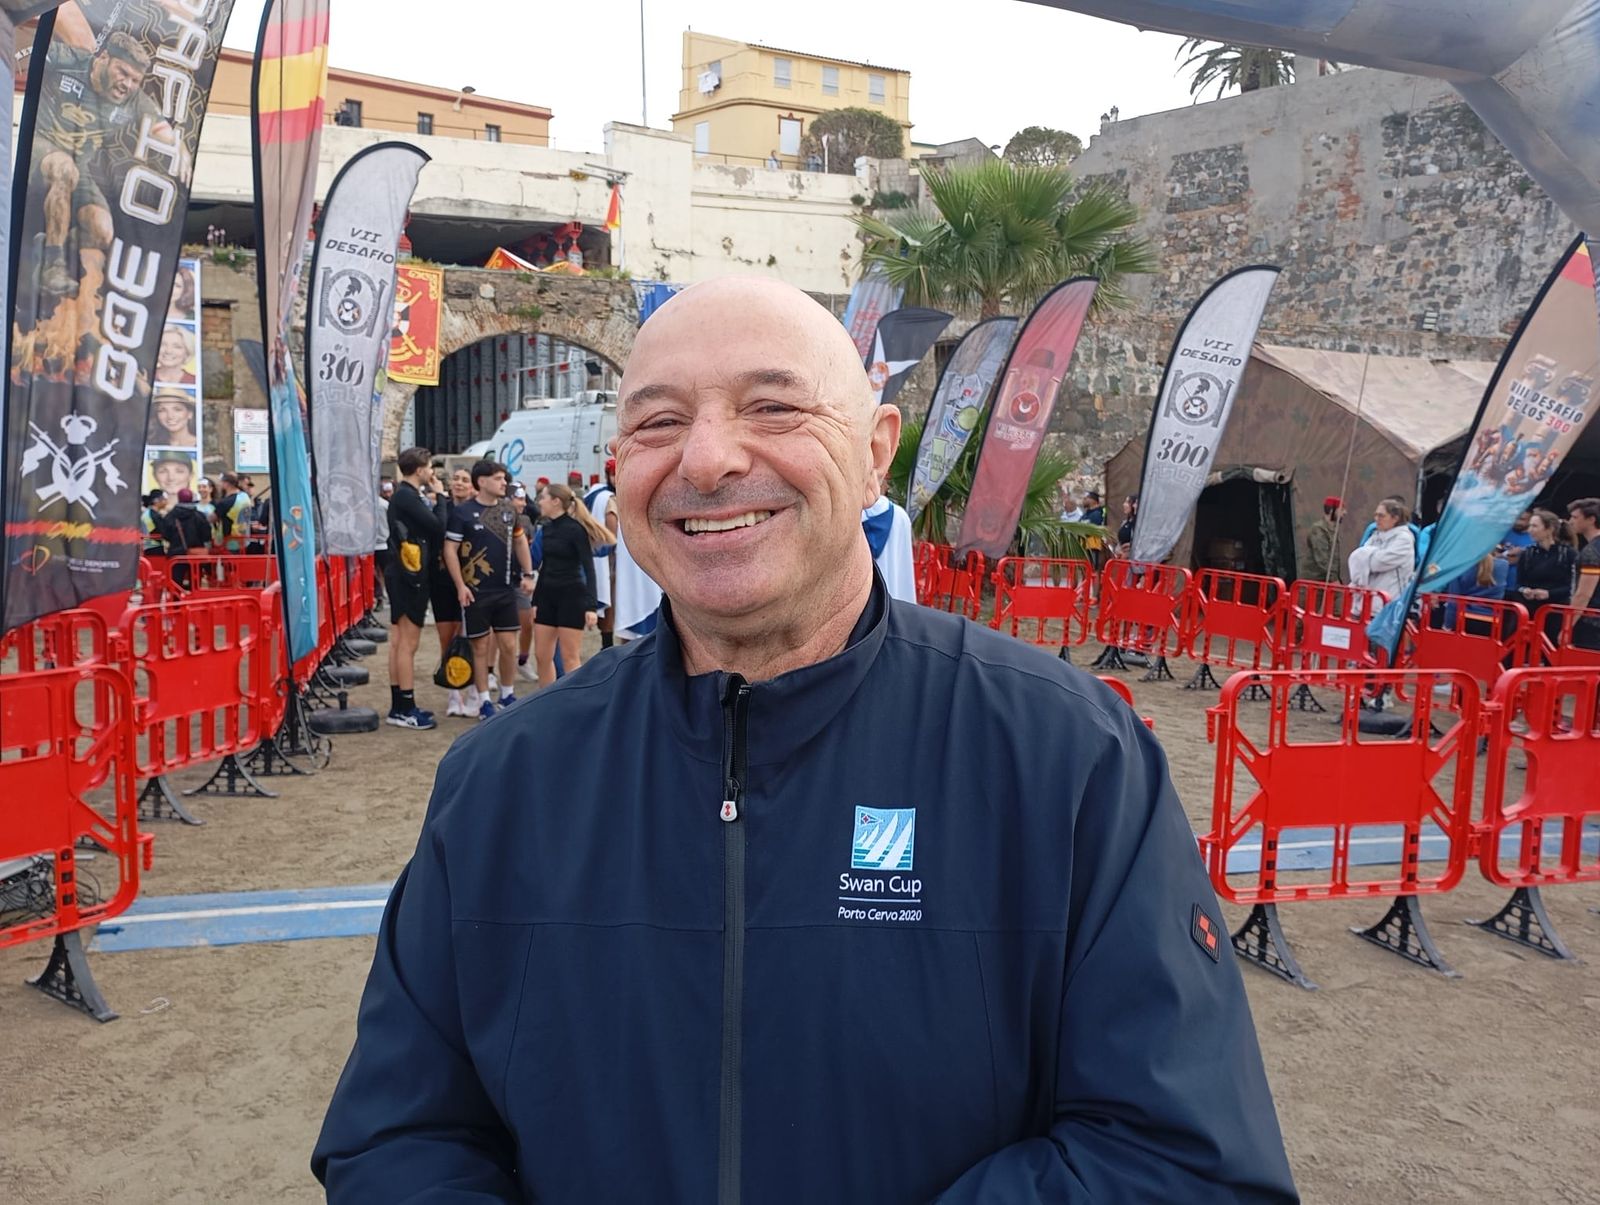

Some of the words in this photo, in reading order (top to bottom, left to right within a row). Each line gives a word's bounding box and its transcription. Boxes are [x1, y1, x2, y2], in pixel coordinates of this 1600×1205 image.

[350, 227, 382, 243] VII
[96, 236, 161, 401] 300
[1203, 338, 1234, 352] VII
[1511, 381, 1531, 399] VIII
[1507, 396, 1522, 411] DE
[1521, 403, 1546, 421] LOS
[1546, 415, 1571, 433] 300
[1157, 438, 1209, 468] 300
[839, 873, 884, 893] Swan
[889, 876, 922, 898] Cup
[838, 906, 866, 920] Porto
[868, 908, 898, 921] Cervo
[898, 909, 922, 922] 2020
